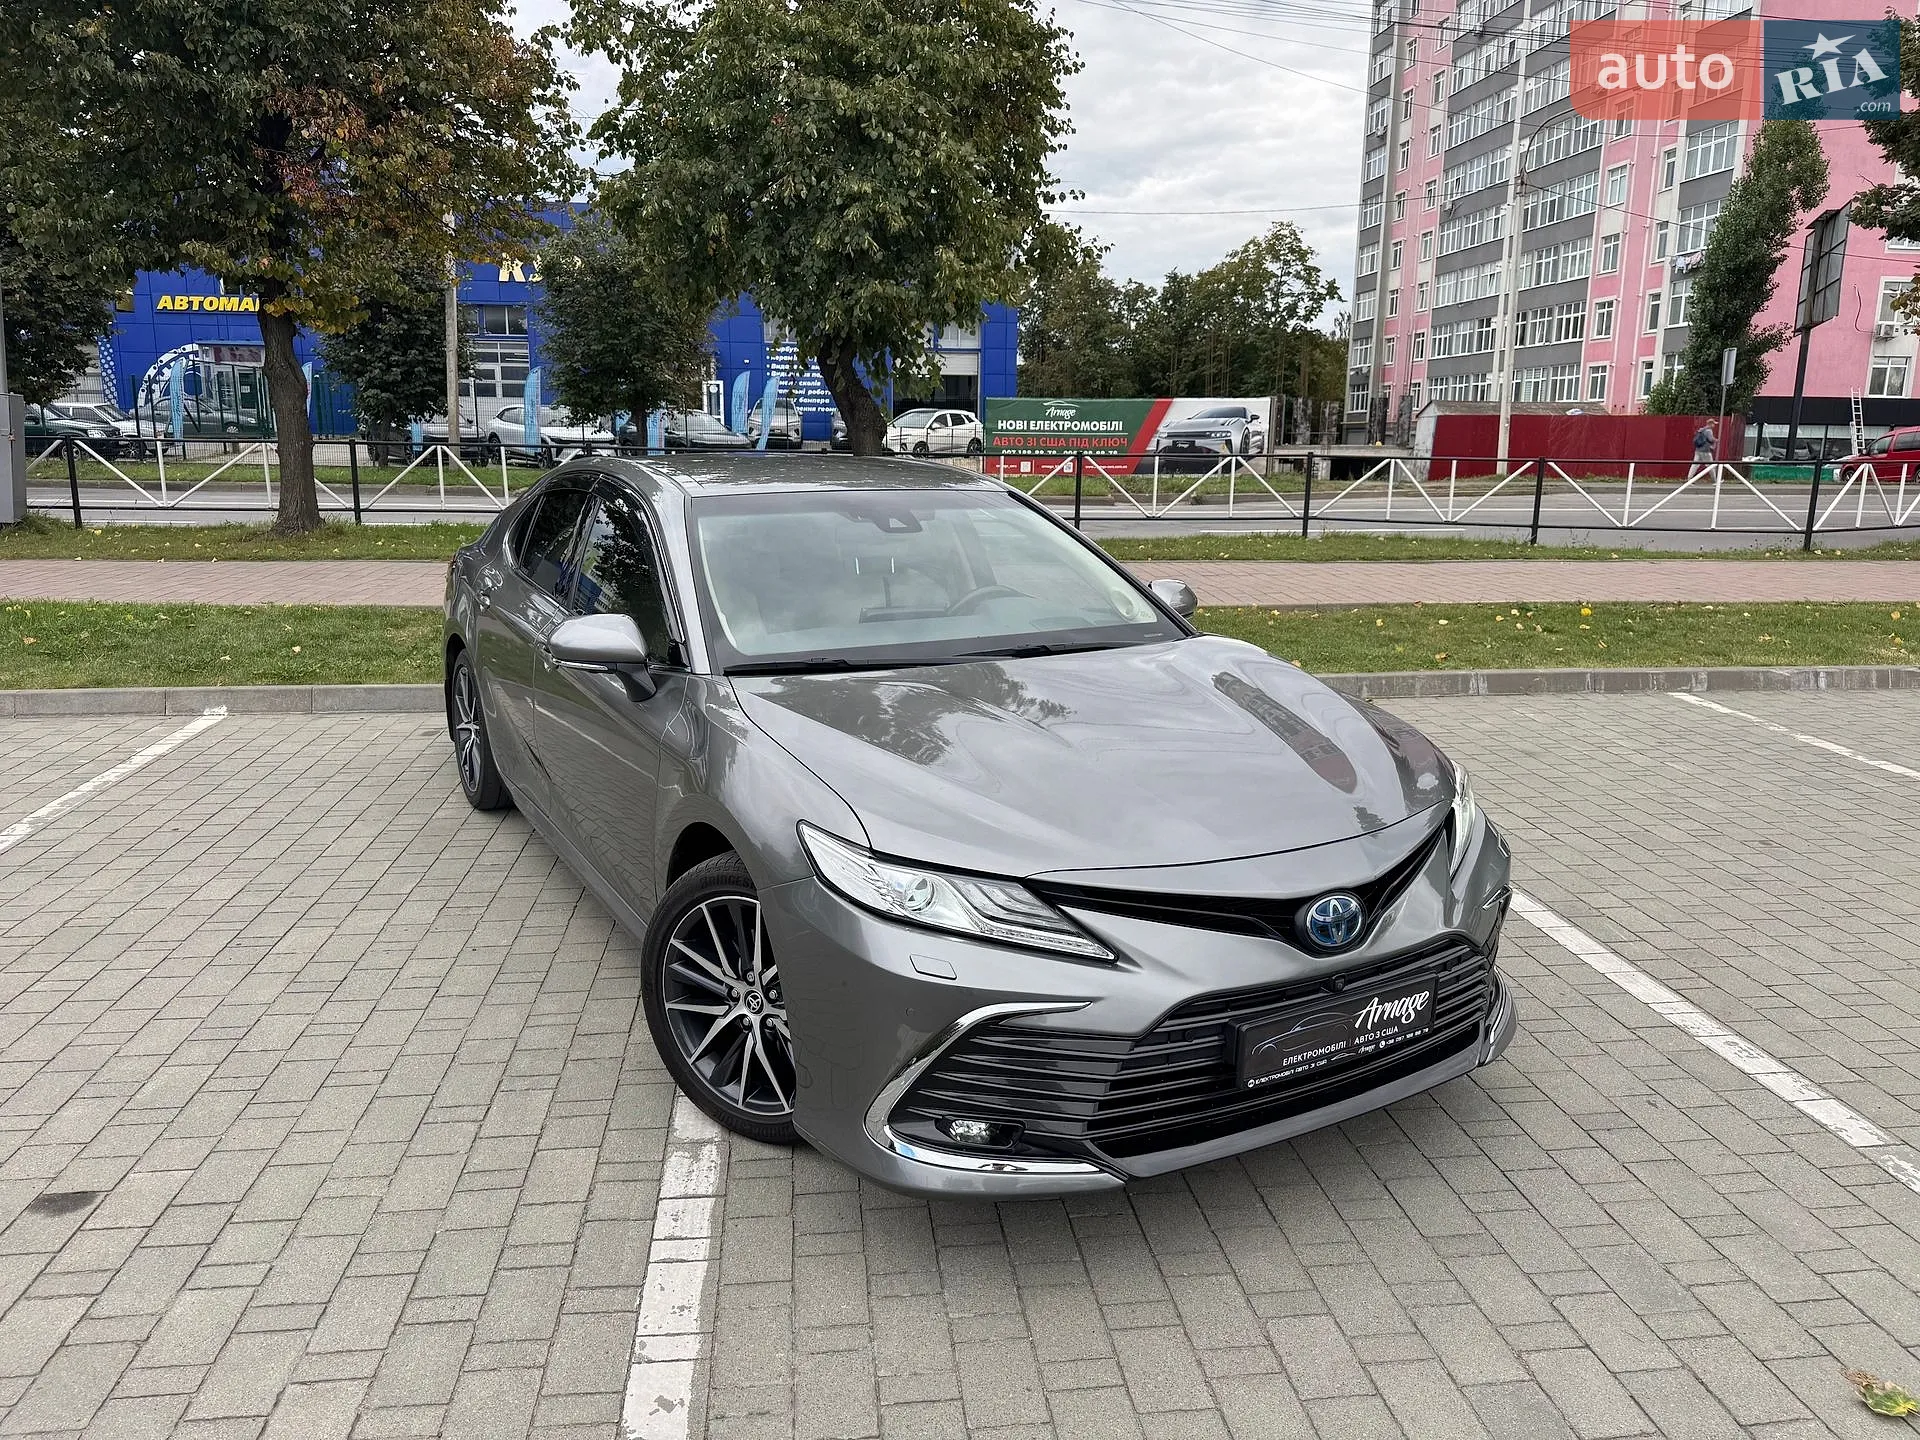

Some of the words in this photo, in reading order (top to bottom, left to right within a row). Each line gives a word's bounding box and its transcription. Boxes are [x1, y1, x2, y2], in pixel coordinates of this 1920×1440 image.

[157, 295, 259, 312] АВТОМА
[1045, 406, 1076, 419] Arnage
[998, 420, 1027, 430] НОВІ
[1030, 420, 1123, 431] ЕЛЕКТРОМОБІЛІ
[993, 437, 1023, 447] АВТО
[1027, 437, 1036, 447] ЗІ
[1040, 437, 1066, 447] США
[1069, 438, 1090, 448] ПІД
[1092, 438, 1128, 448] КЛЮЧ
[1353, 991, 1430, 1030] Arnage
[1282, 1040, 1347, 1066] ЕЛЕКТРОМОБІЛІ
[1354, 1033, 1374, 1045] АВТО
[1381, 1026, 1398, 1037] США
